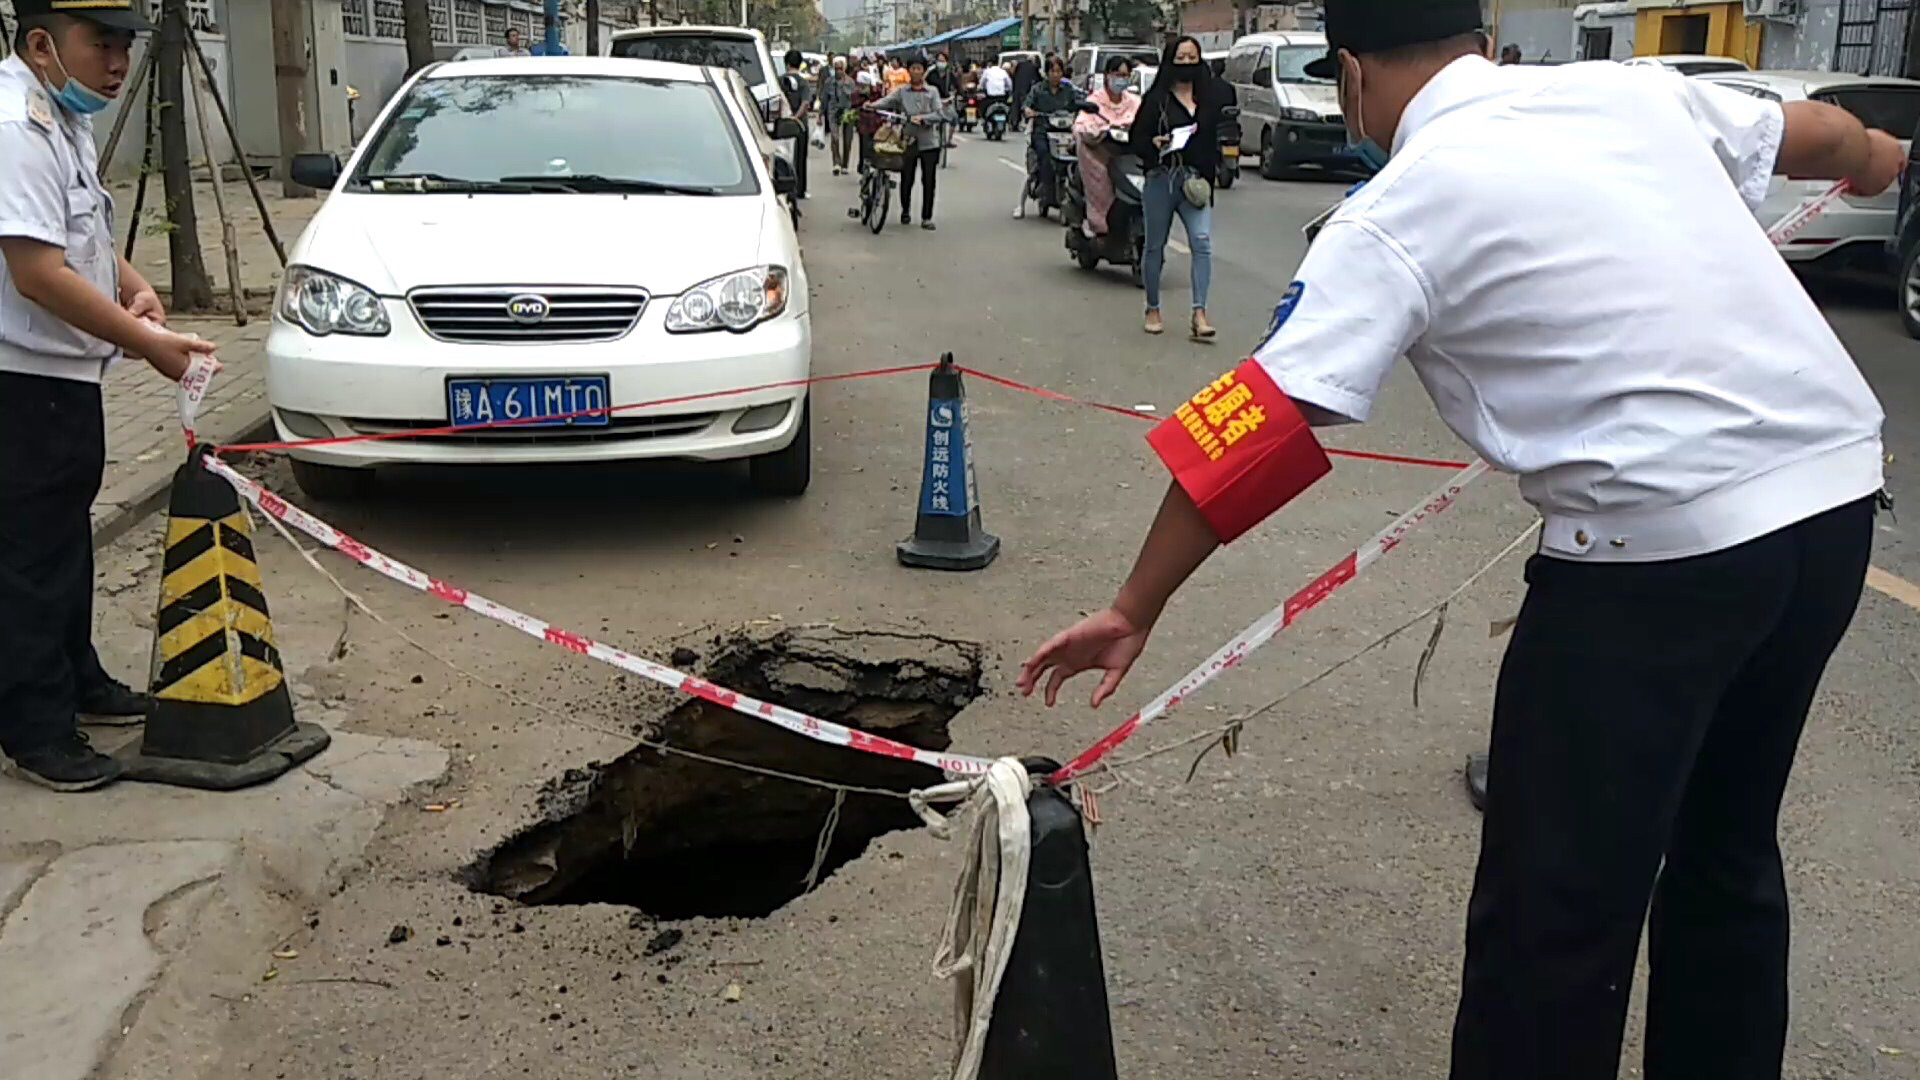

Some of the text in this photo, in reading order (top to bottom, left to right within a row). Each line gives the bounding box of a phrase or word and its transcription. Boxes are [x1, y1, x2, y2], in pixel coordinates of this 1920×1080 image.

[513, 302, 543, 314] BYD
[931, 429, 950, 512] 创远防火线
